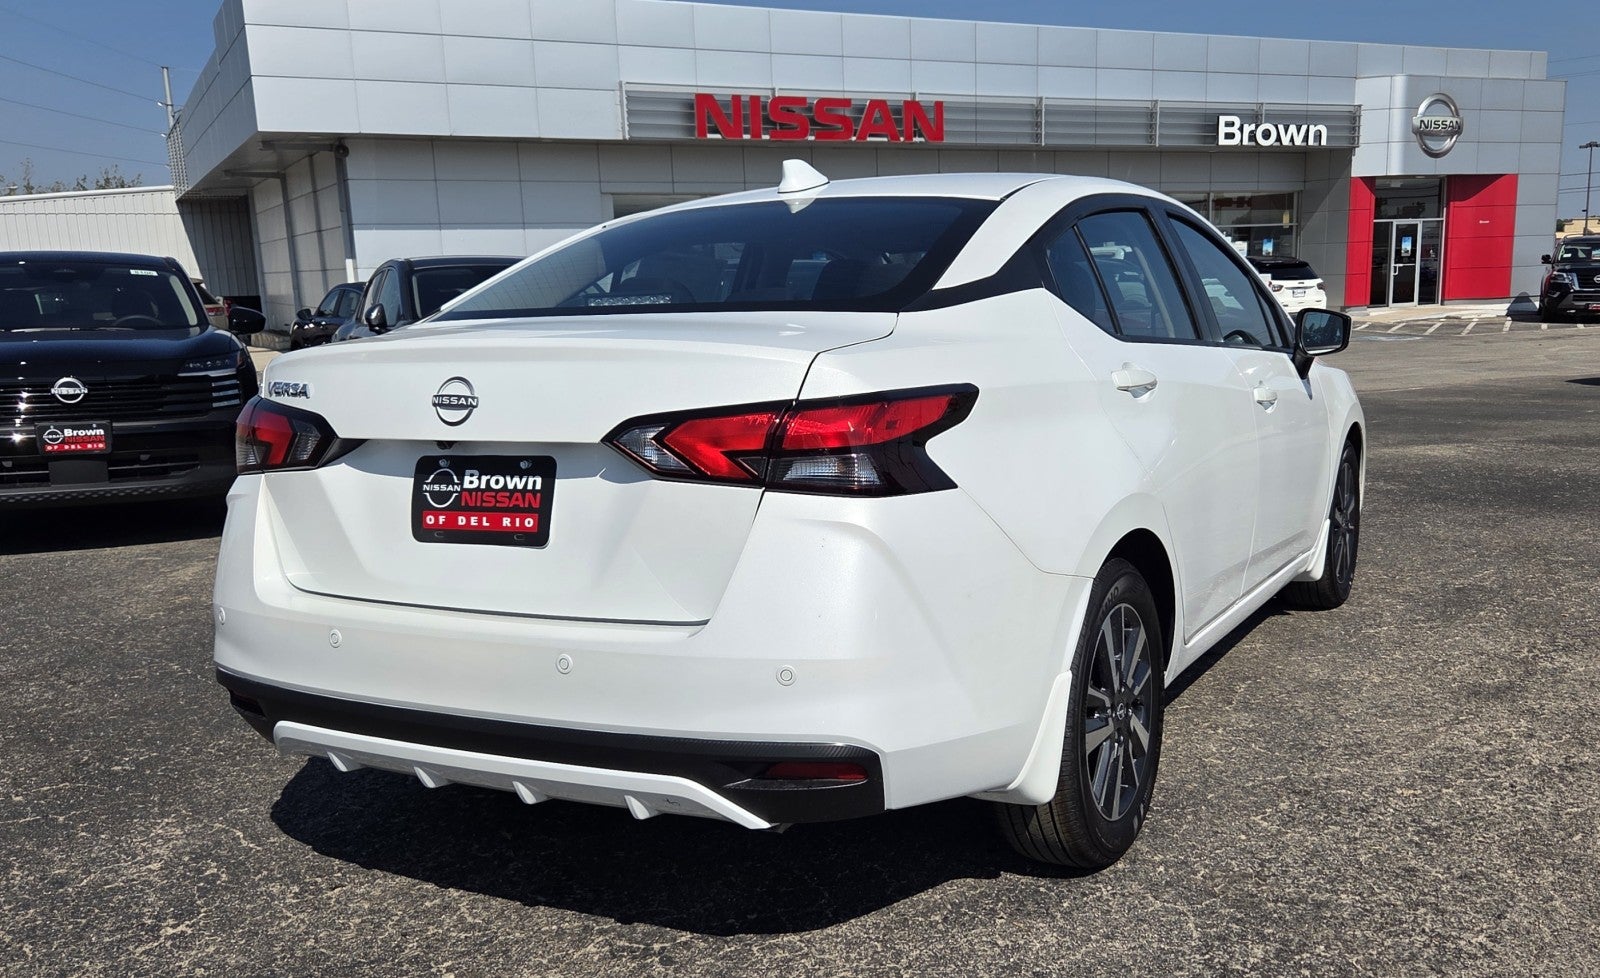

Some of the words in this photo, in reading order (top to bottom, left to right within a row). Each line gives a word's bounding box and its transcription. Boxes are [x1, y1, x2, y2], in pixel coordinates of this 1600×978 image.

[694, 93, 945, 142] NISSAN
[1419, 119, 1461, 131] NISSAN
[1218, 115, 1328, 147] Brown
[268, 382, 310, 399] VERSA
[432, 396, 478, 406] NISSAN
[64, 428, 105, 437] Brown
[463, 469, 542, 490] Brown
[422, 483, 461, 492] NISSAN
[461, 491, 541, 508] NISSAN
[425, 515, 446, 525] OF
[457, 516, 490, 527] DEL
[502, 517, 534, 528] RIO
